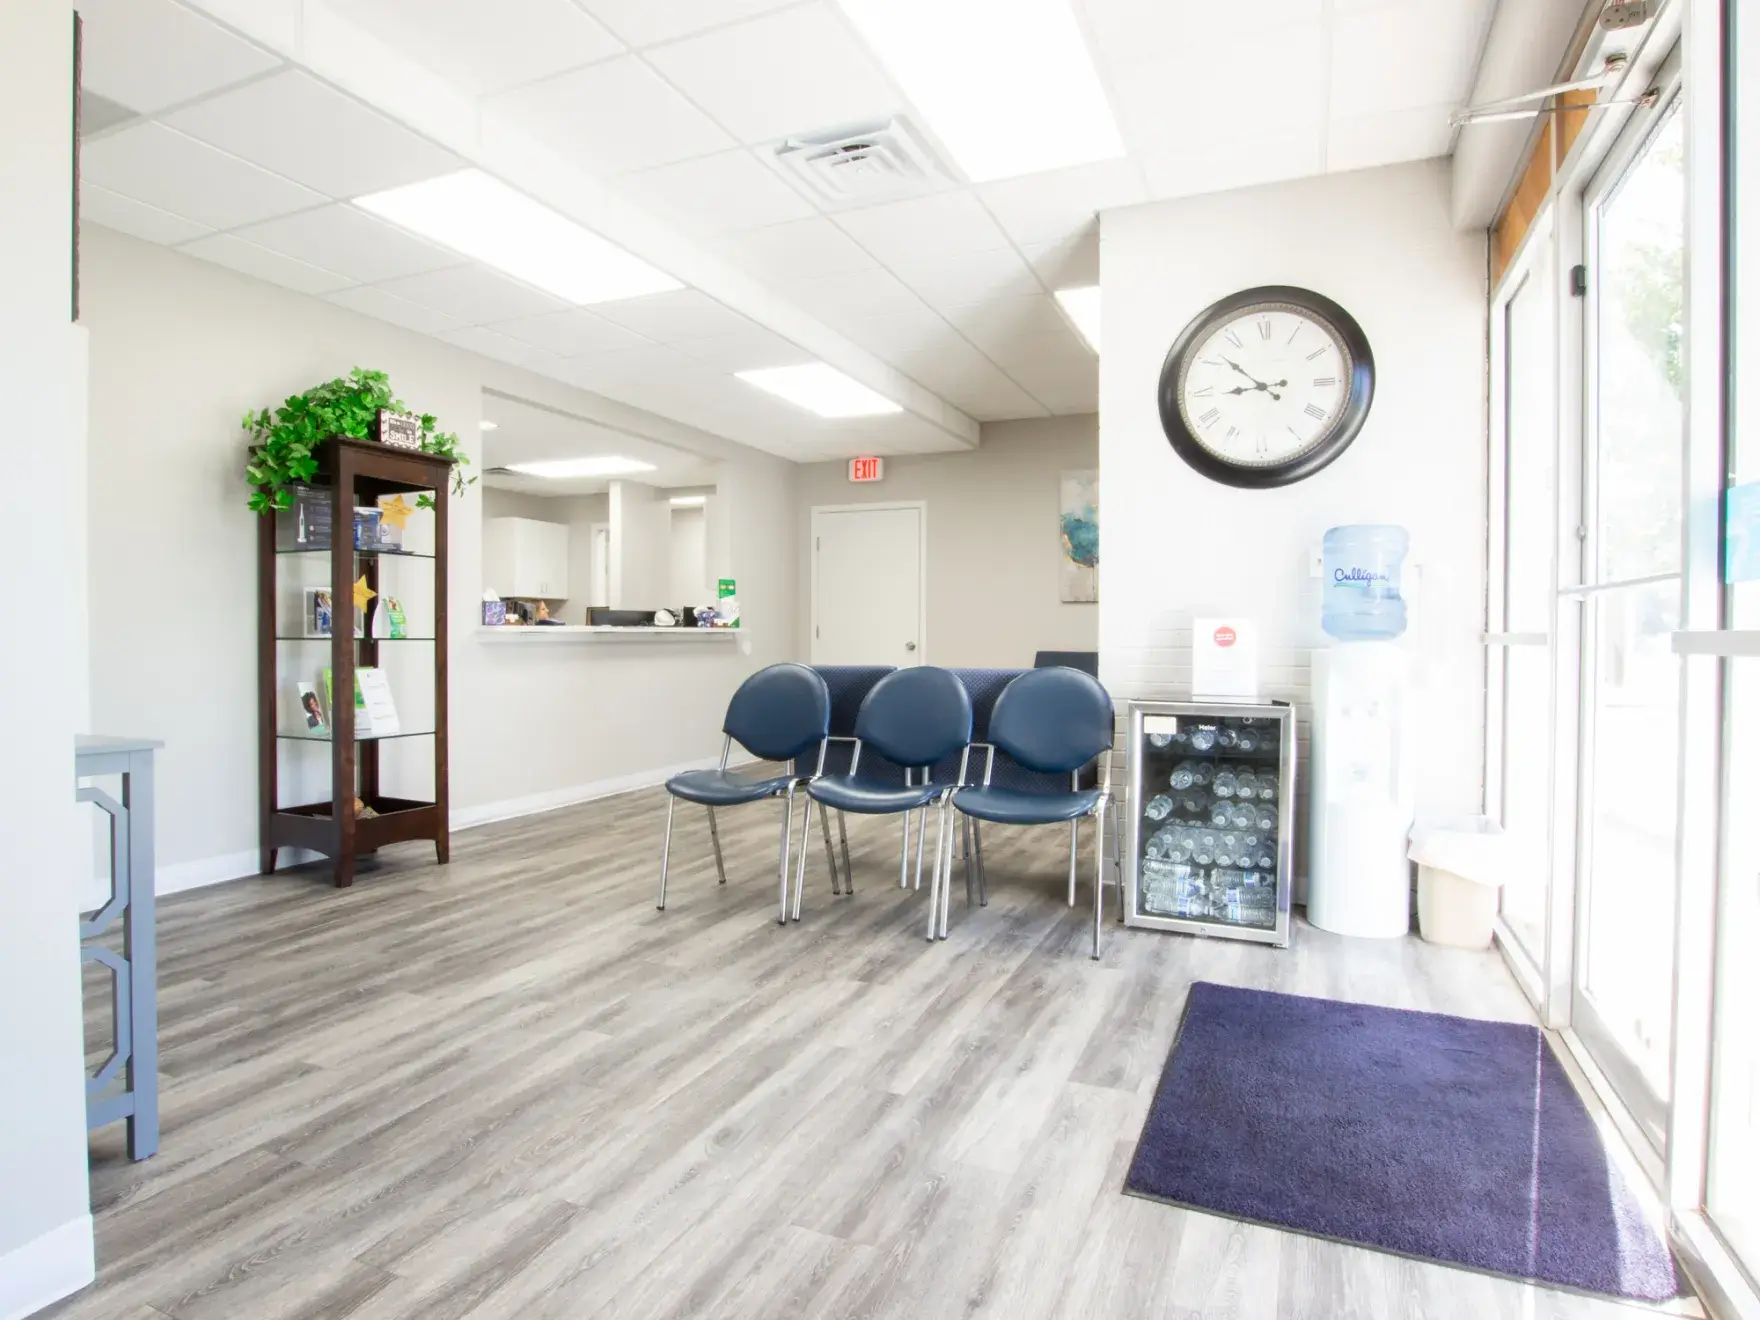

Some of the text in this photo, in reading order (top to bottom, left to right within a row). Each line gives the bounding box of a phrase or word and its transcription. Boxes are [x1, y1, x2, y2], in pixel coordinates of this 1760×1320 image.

[389, 429, 415, 444] SMILE
[854, 459, 878, 479] EXIT
[1334, 567, 1389, 588] Culligan
